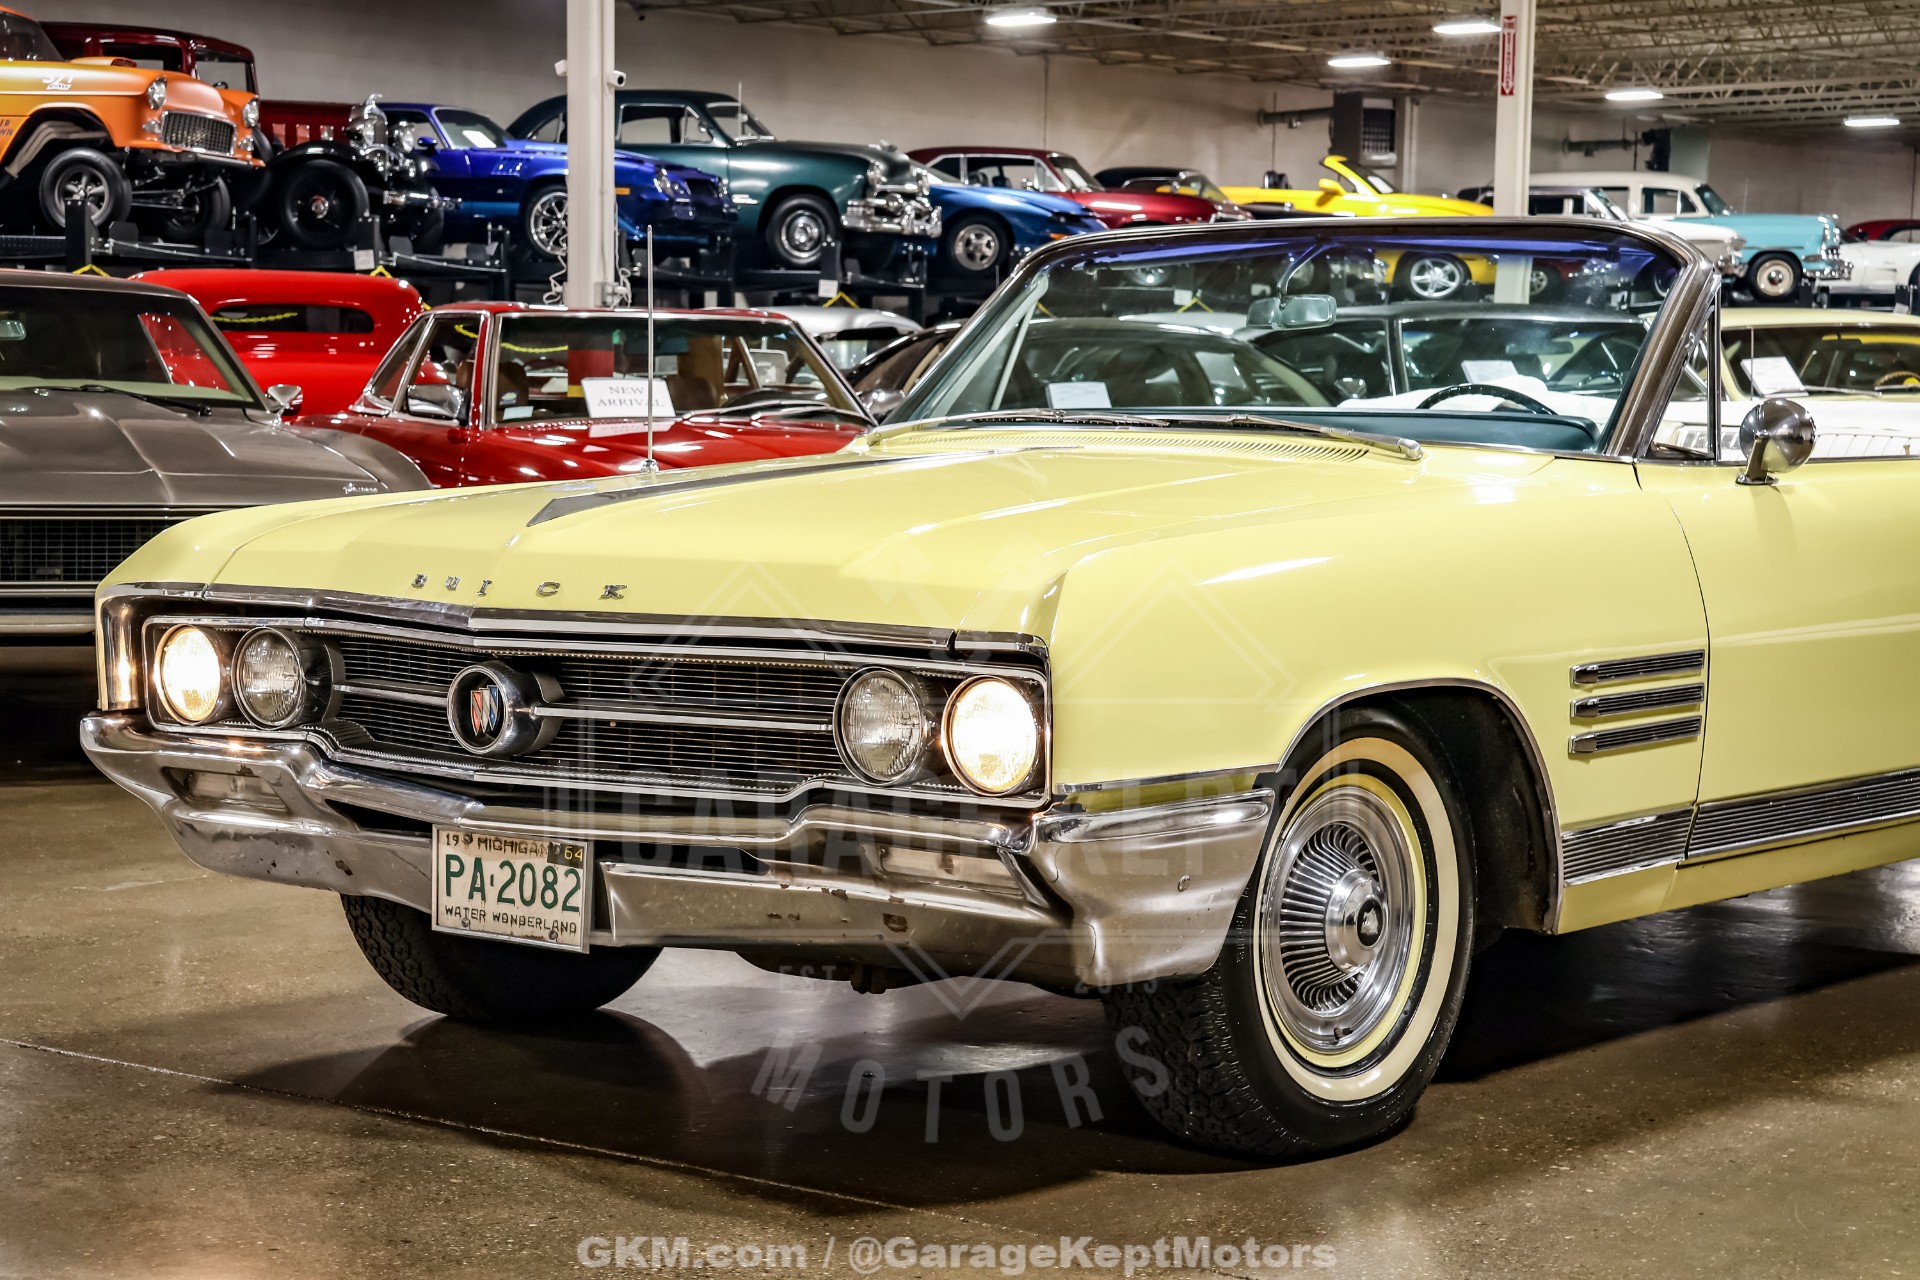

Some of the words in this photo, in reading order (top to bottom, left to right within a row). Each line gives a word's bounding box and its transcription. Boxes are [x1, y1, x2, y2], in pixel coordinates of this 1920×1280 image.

[609, 386, 644, 394] NEW
[411, 573, 628, 600] BUICK
[477, 836, 549, 858] MICHIGAN
[564, 845, 583, 862] 64
[445, 905, 487, 921] WATER
[492, 911, 577, 935] WONDERLAND
